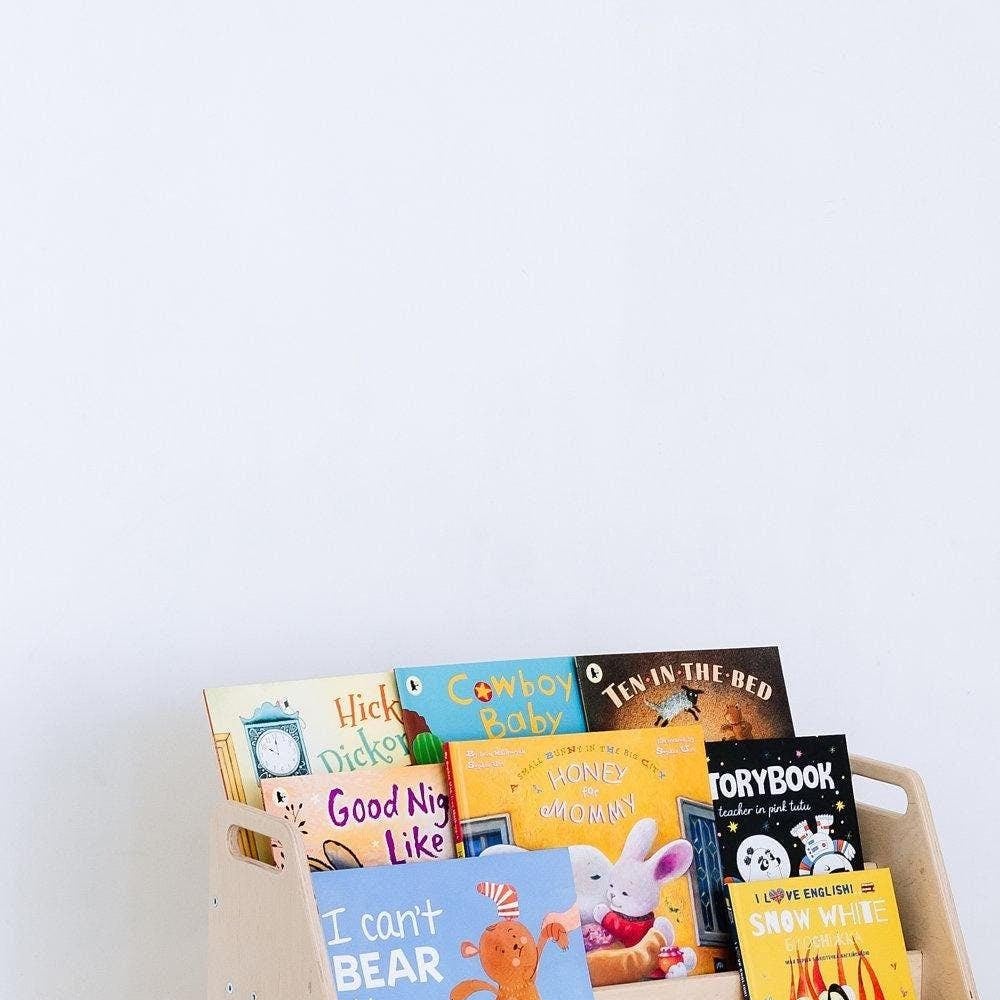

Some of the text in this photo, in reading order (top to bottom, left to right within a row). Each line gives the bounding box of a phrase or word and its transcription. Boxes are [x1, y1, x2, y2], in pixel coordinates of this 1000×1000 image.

[447, 669, 573, 706] Cowboy
[602, 662, 773, 708] TEN IN THE BED
[333, 684, 404, 729] Hick
[479, 701, 563, 739] Baby
[547, 760, 628, 790] HONEY
[328, 784, 398, 827] Good
[407, 782, 449, 828] Nig
[540, 792, 636, 824] MOMMY
[718, 800, 811, 817] teacher in pink tutu
[385, 826, 443, 866] Like
[754, 893, 760, 904] I
[803, 883, 854, 899] ENGLISH!
[321, 899, 443, 946] I can't
[748, 907, 810, 937] SNOW
[818, 899, 889, 928] WHITE
[332, 946, 444, 992] BEAR
